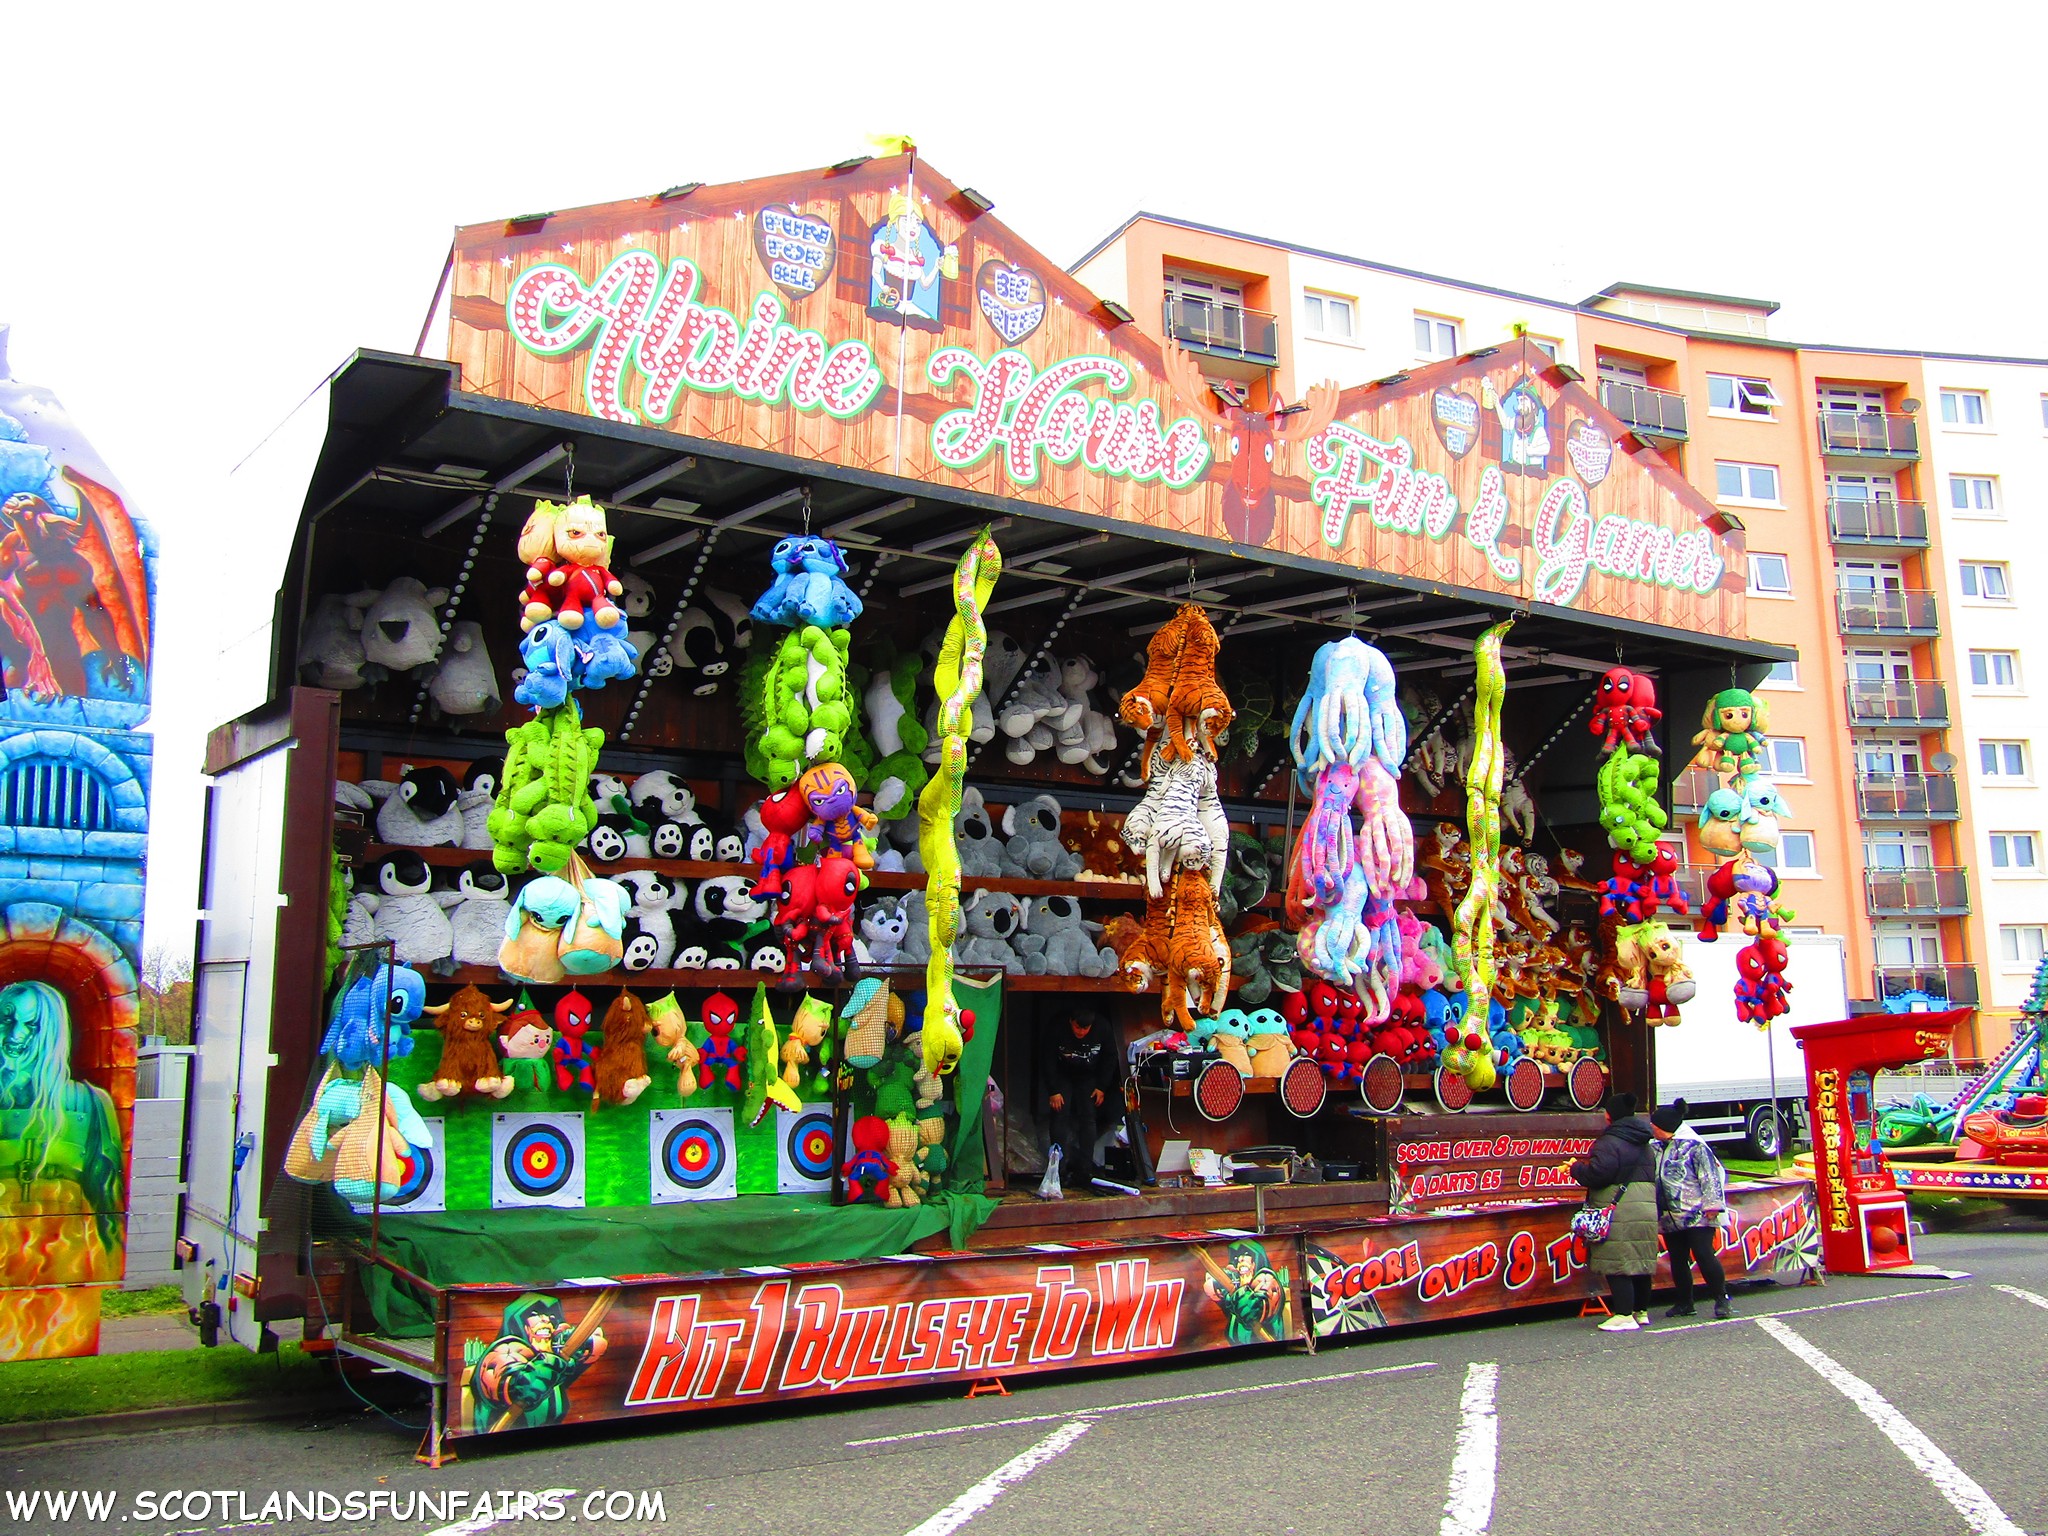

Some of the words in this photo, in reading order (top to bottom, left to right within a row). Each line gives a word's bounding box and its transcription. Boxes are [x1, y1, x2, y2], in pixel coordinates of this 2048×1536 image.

[763, 210, 831, 247] FUN
[766, 235, 825, 269] FOR
[772, 261, 816, 291] ALL
[995, 270, 1031, 305] BIG
[980, 289, 1044, 342] PRIZES
[507, 249, 882, 424] Alpine
[926, 347, 1211, 489] House
[1307, 420, 1458, 547] Fun
[1533, 476, 1725, 606] Games
[1397, 1141, 1451, 1163] SCORE
[1453, 1139, 1493, 1159] OVER
[1492, 1135, 1511, 1157] 8
[1510, 1139, 1530, 1155] TO
[1531, 1139, 1562, 1155] WIN
[1561, 1138, 1596, 1155] ANY
[2003, 1129, 2021, 1137] TOY
[1412, 1175, 1427, 1198] 4
[1427, 1171, 1478, 1197] DARTS
[1480, 1169, 1502, 1191] £5
[1519, 1165, 1533, 1187] 5
[1323, 1239, 1422, 1314] SCORE
[1418, 1241, 1499, 1302] OVER
[1503, 1230, 1536, 1290] 8
[1742, 1192, 1810, 1270] PRIZE
[624, 1292, 746, 1406] HIT
[735, 1278, 792, 1395] 1
[778, 1283, 1033, 1391] BULLSEYE
[1028, 1264, 1092, 1363] TO
[1091, 1258, 1186, 1355] WIN
